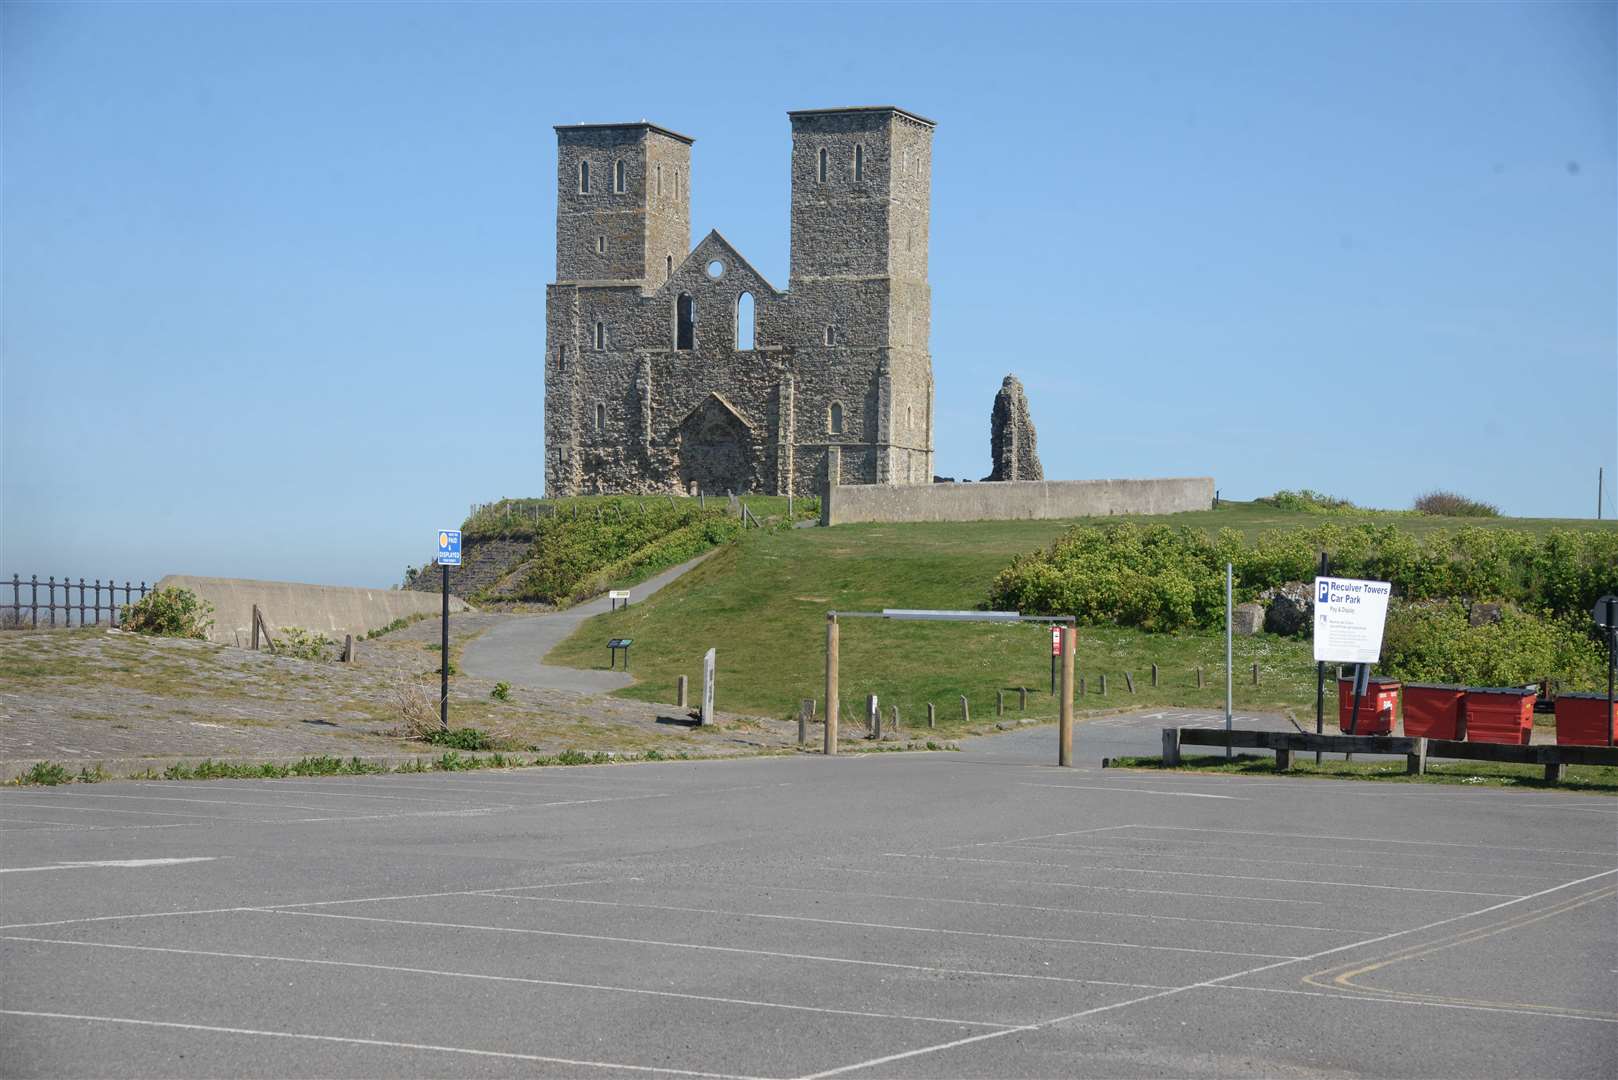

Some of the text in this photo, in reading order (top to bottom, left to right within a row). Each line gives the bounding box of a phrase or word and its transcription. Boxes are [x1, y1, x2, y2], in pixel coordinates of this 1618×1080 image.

[1319, 583, 1328, 600] P
[1330, 581, 1388, 595] Reculver Towers
[1330, 593, 1361, 604] Car Park
